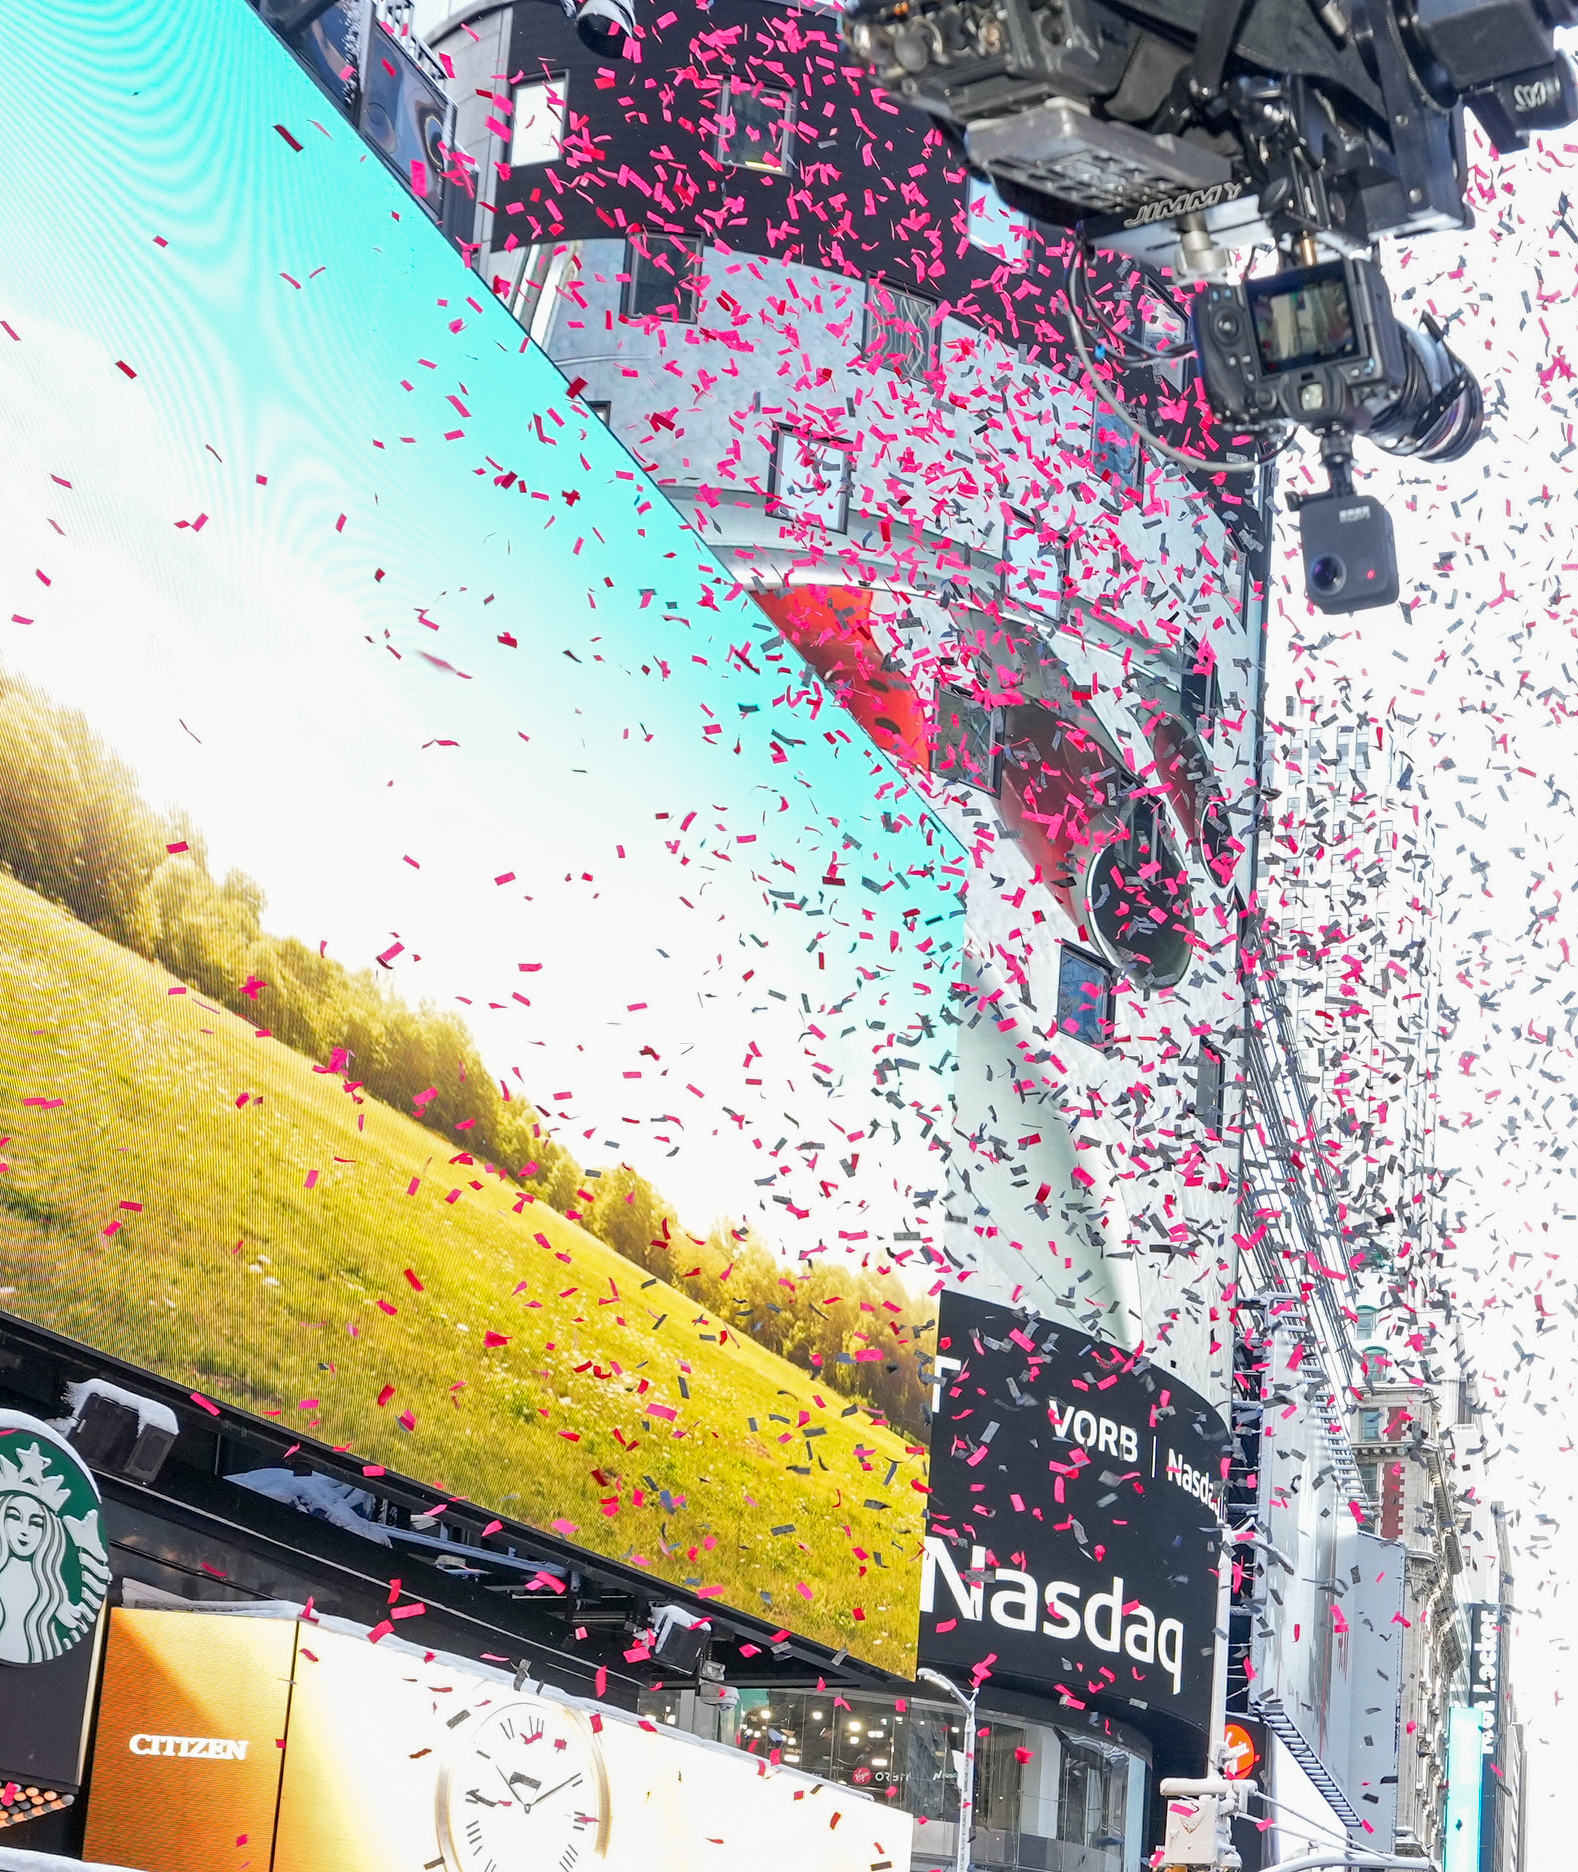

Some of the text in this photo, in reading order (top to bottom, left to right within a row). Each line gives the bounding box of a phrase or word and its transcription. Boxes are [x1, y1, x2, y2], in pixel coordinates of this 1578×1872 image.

[1123, 181, 1243, 229] JIMMY
[1049, 1399, 1138, 1463] VORB
[920, 1535, 1185, 1695] Nasdaq
[129, 1734, 249, 1760] CITIZEN
